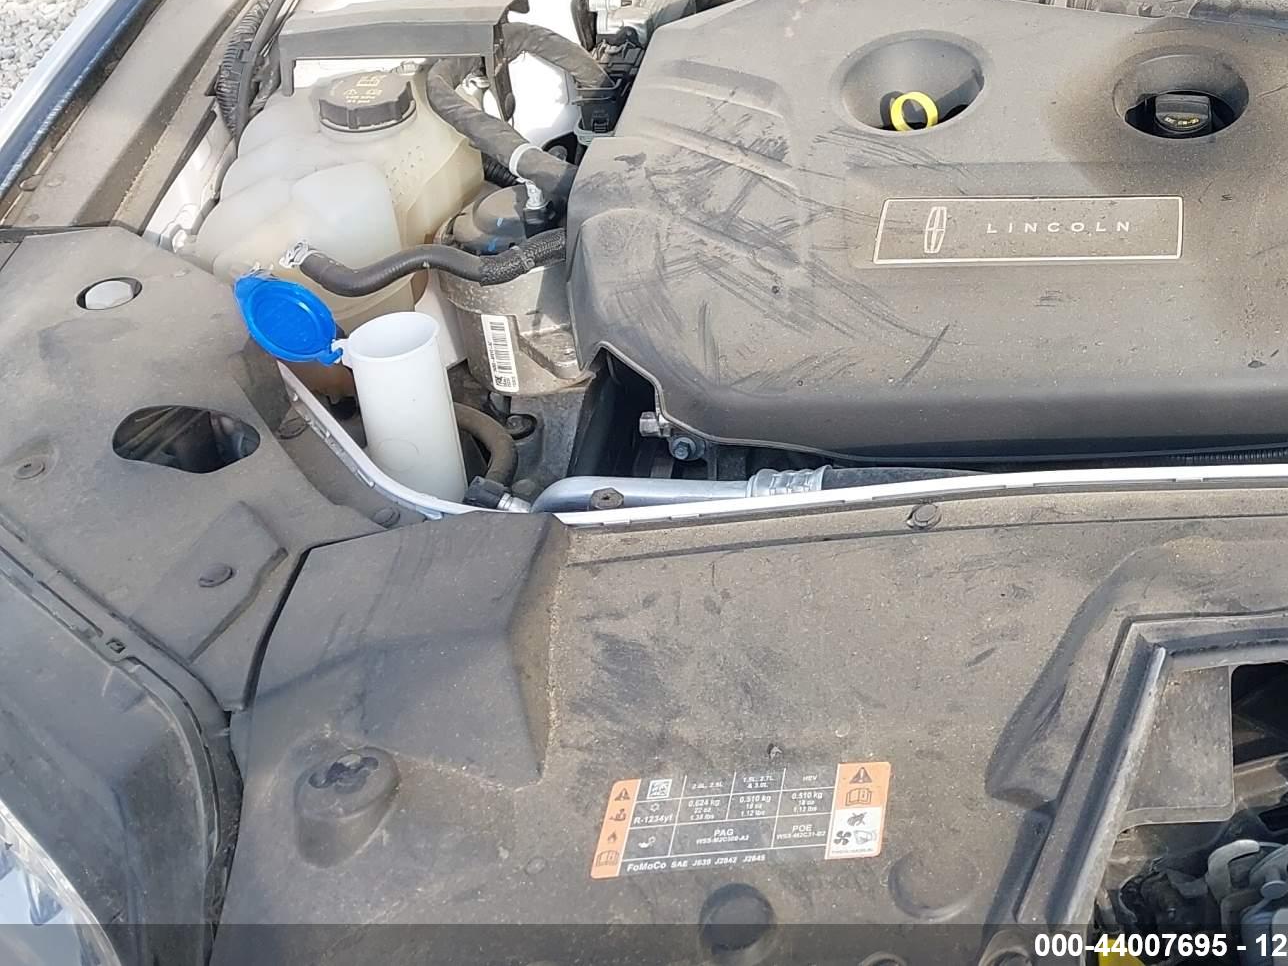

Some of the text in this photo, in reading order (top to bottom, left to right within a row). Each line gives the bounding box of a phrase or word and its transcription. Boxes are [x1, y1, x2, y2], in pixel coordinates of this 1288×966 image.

[986, 221, 1130, 234] LINCOLN
[739, 794, 772, 803] 0.510 kg
[791, 791, 824, 800] 0.510 kg
[710, 799, 721, 807] kg
[633, 813, 674, 825] R-1234yf
[713, 828, 735, 837] PAG
[791, 824, 813, 833] POE
[626, 862, 667, 872] FoMoCo
[670, 860, 689, 868] SAE
